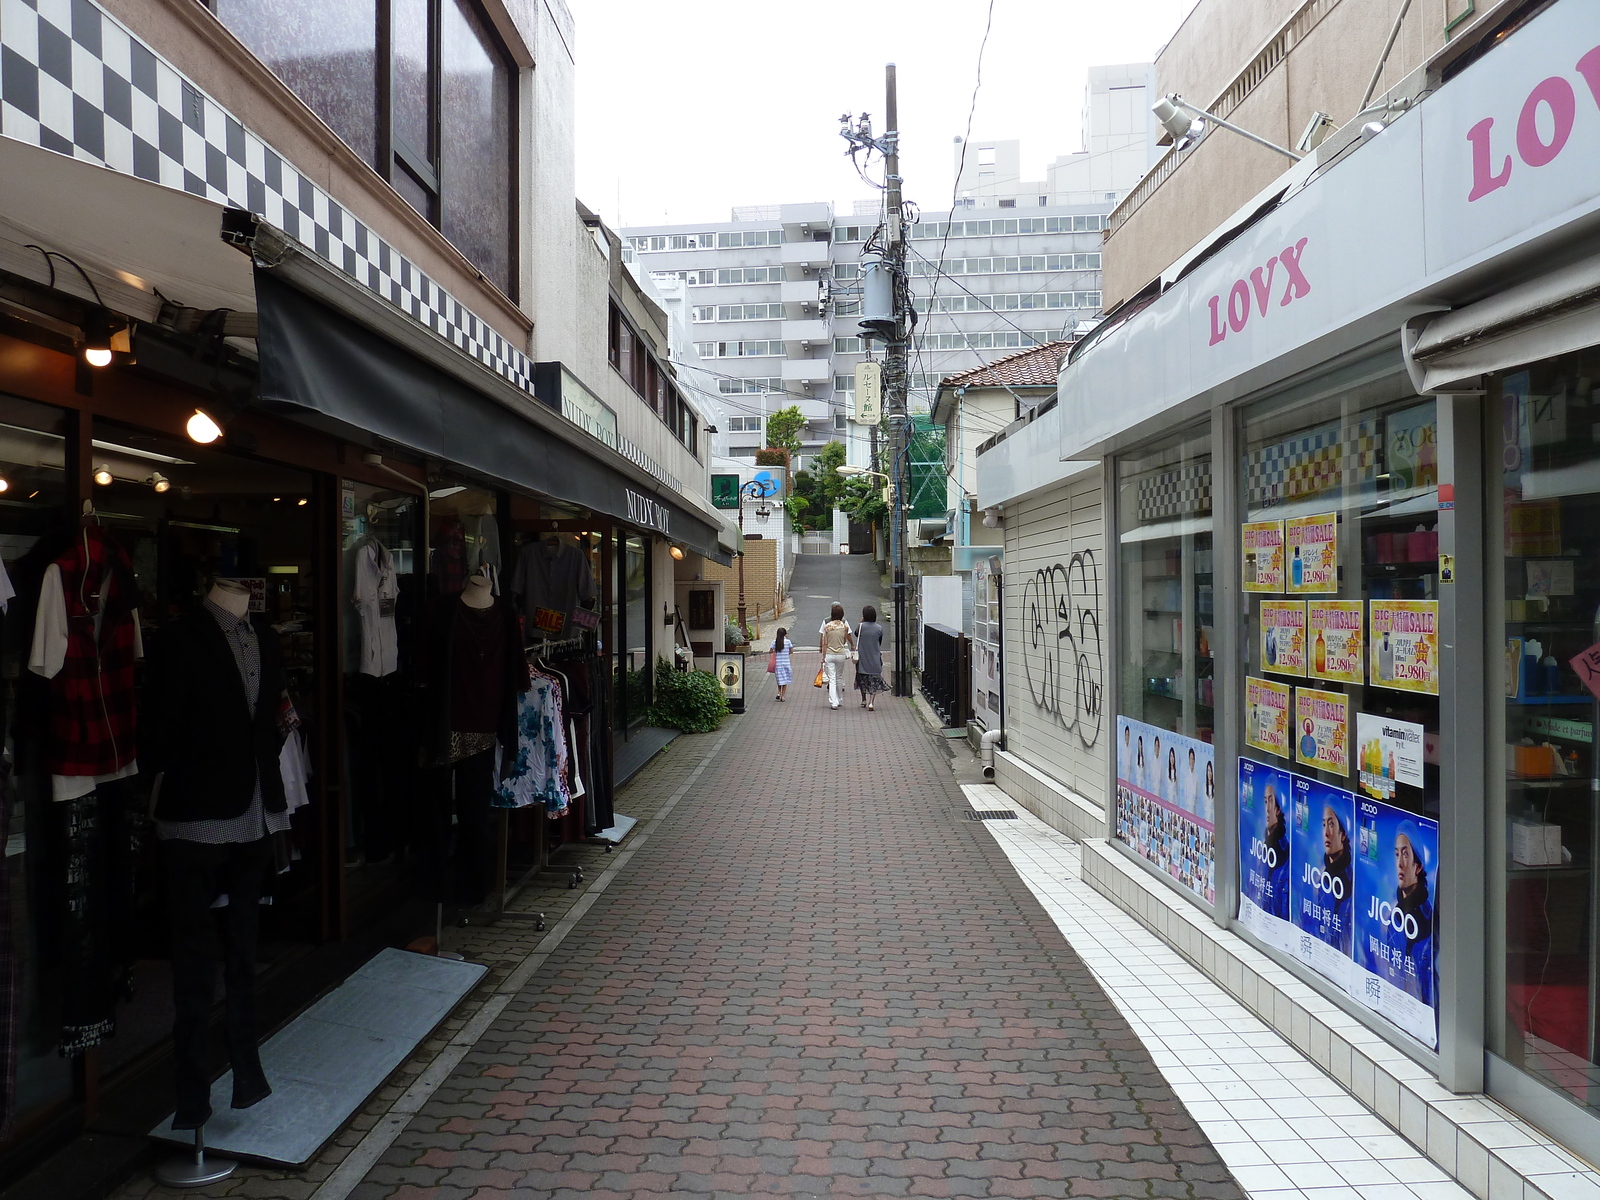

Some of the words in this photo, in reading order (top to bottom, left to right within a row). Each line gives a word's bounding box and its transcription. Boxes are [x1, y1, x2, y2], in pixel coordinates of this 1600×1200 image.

[1208, 237, 1311, 347] LOVX
[625, 488, 655, 527] NUDY
[1289, 526, 1300, 537] BIG
[1315, 523, 1333, 542] SALE
[534, 608, 563, 631] SALE
[1263, 608, 1273, 618] BIG
[1286, 611, 1303, 628] SALE
[1312, 609, 1324, 619] BIG
[1339, 611, 1359, 630] SALE
[1374, 609, 1389, 620] BIG
[1409, 612, 1434, 633] SALE
[1299, 696, 1311, 707] BIG
[1325, 702, 1345, 723] SALE
[1382, 725, 1420, 744] vitaminwater
[1361, 802, 1378, 815] JICOO
[1249, 836, 1277, 868] JICOO
[1249, 868, 1274, 898] 岡田将生
[1302, 862, 1344, 900] JICOO
[1303, 897, 1342, 933] 岡田将生
[1367, 895, 1419, 940] JICOO
[1369, 934, 1417, 977] 岡田将生
[1365, 976, 1381, 1005] 瞬
